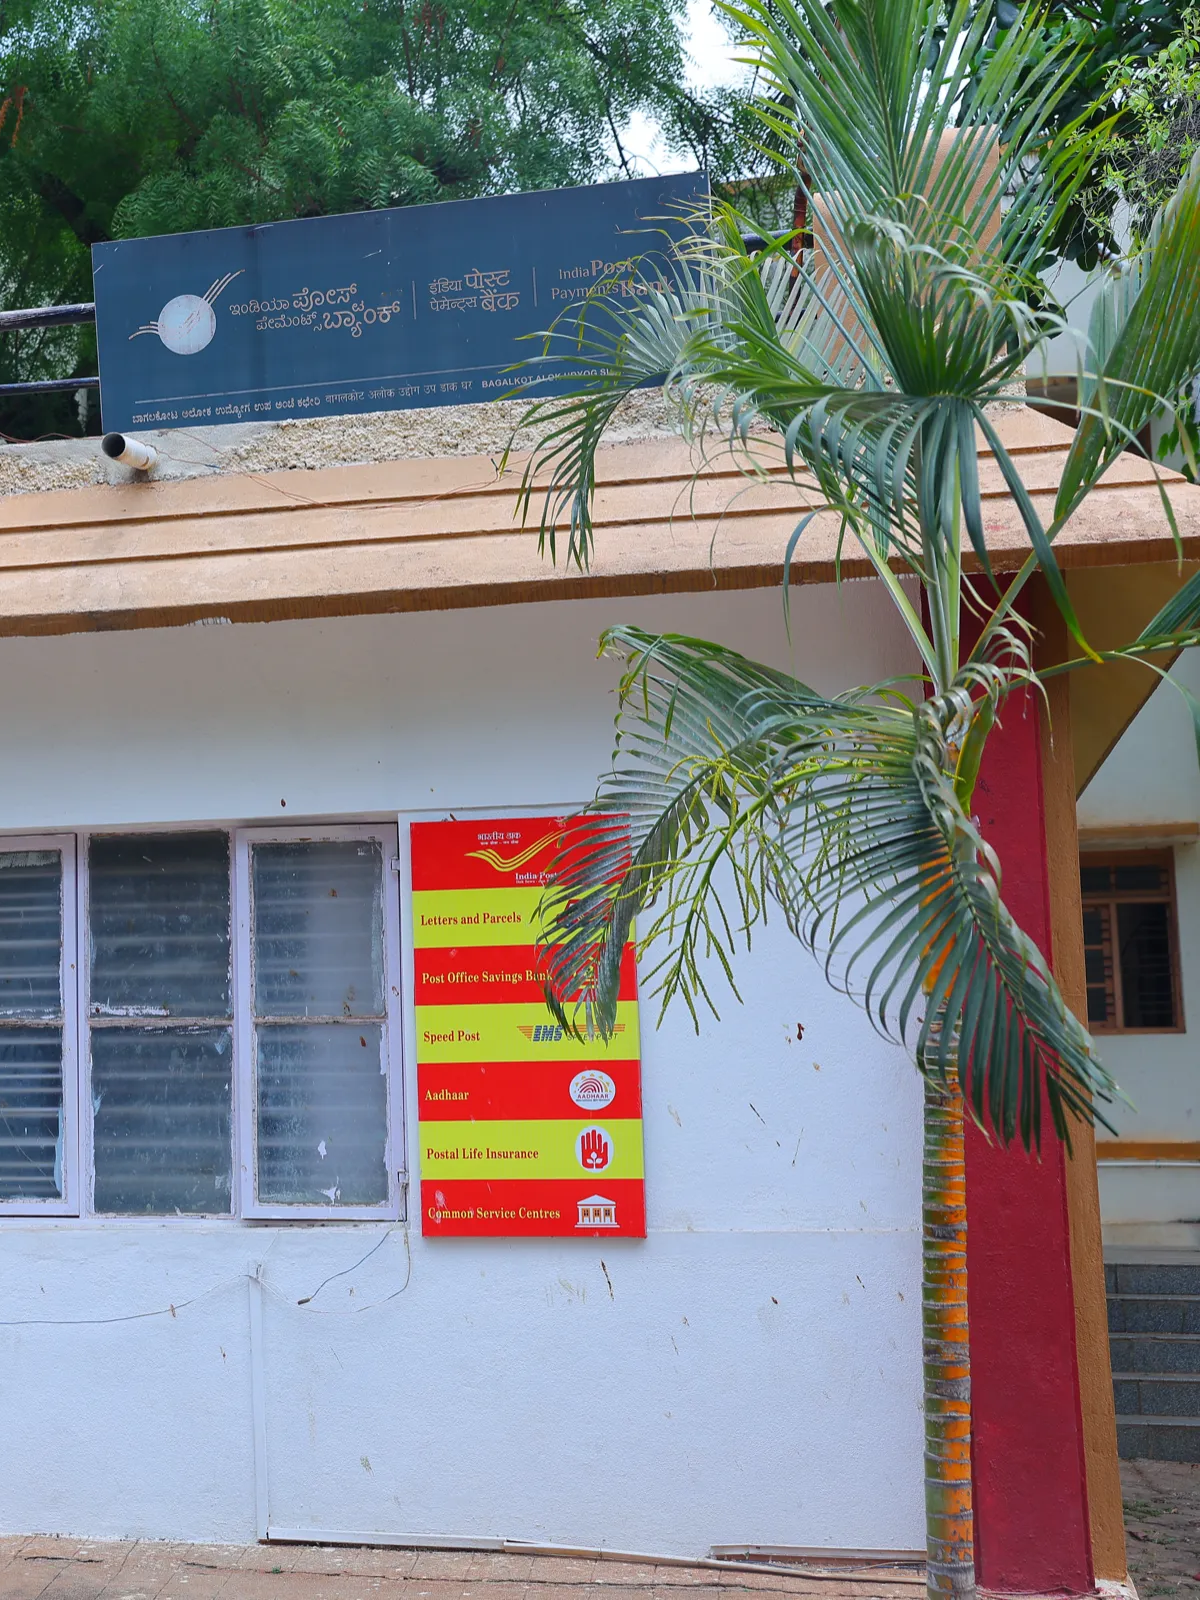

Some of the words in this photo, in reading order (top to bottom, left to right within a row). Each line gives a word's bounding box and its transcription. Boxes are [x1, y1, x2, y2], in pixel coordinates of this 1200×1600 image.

[559, 266, 590, 280] India
[590, 257, 636, 276] Post
[428, 277, 463, 295] इंडिया
[464, 268, 510, 289] पोस्ट
[229, 297, 290, 316] ಇಂಡಿಯಾ
[479, 289, 521, 312] बैंक
[440, 382, 458, 392] डाक
[482, 376, 533, 388] BAGALKOT
[515, 872, 537, 880] India
[421, 915, 458, 926] Letters
[461, 913, 480, 924] and
[483, 911, 521, 923] Parcels
[422, 972, 445, 984] Post
[447, 971, 479, 983] Office
[482, 970, 523, 984] Savings
[423, 1030, 455, 1044] Speed
[457, 1030, 481, 1041] Post
[533, 1025, 563, 1042] EMS
[596, 1033, 618, 1041] PST
[425, 1089, 469, 1101] Aadhaar
[426, 1148, 459, 1159] Postal
[462, 1147, 483, 1159] Life
[486, 1147, 539, 1159] Insurance
[428, 1207, 474, 1219] Common
[476, 1207, 516, 1219] Service
[518, 1206, 561, 1219] Centres
